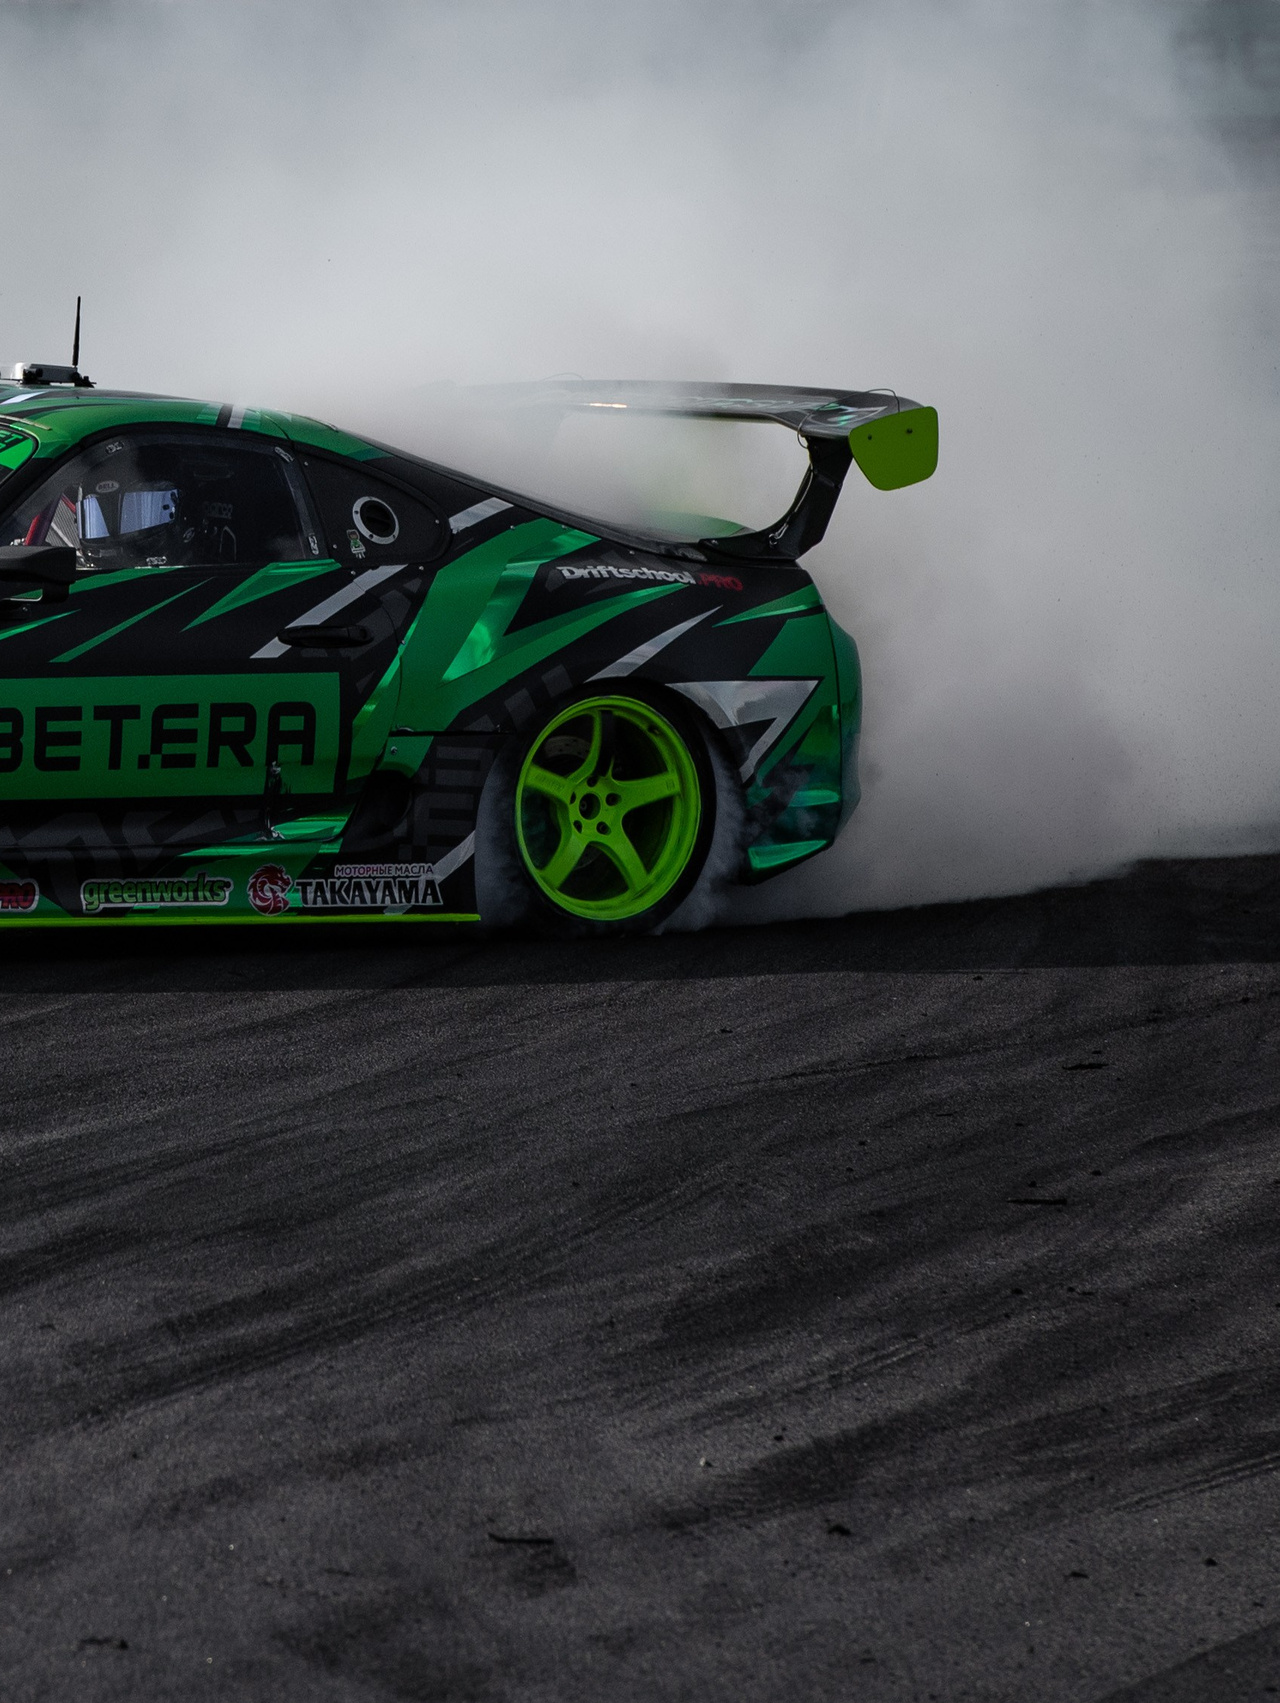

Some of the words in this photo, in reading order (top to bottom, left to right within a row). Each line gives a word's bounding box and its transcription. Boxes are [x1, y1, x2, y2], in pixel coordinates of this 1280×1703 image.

[335, 864, 393, 876] МОТОРНЫЕ
[395, 863, 434, 875] МАСЛА
[83, 872, 228, 910] greenworks
[297, 880, 441, 905] TAKAYAMA
